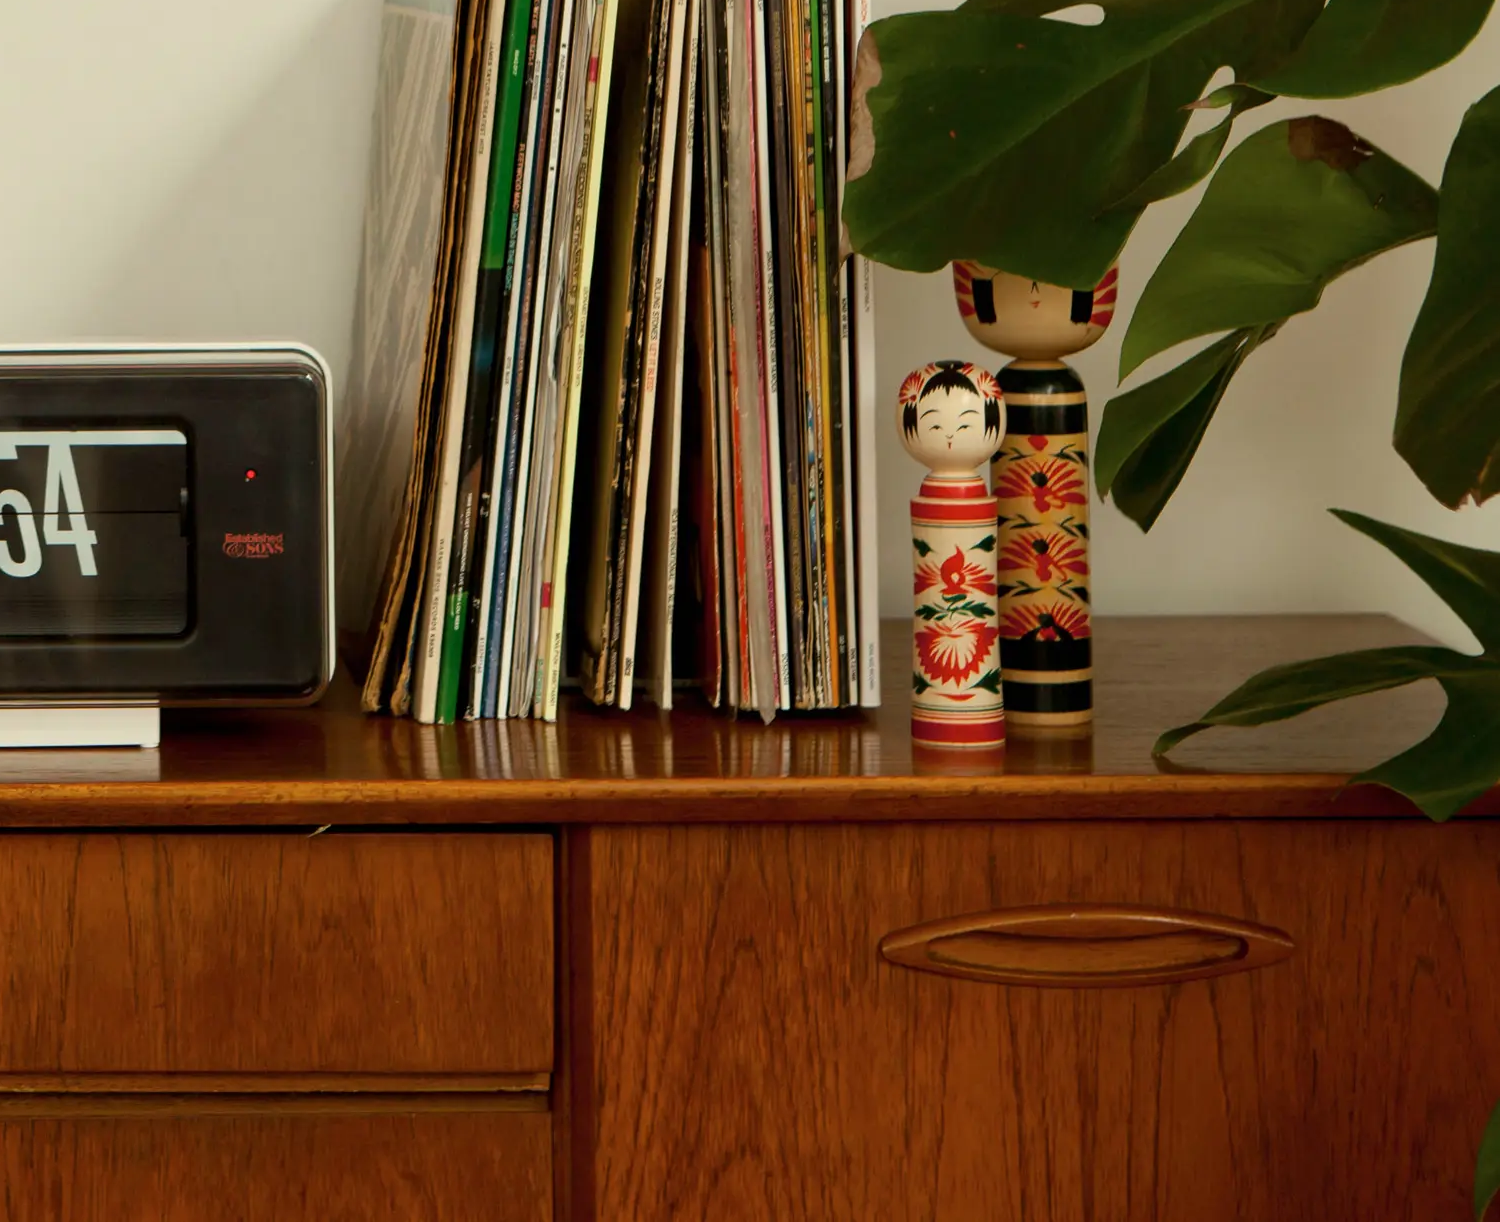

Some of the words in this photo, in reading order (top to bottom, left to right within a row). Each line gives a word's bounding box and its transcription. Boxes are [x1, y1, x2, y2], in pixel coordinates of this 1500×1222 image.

[487, 40, 495, 66] JAMES
[484, 68, 493, 96] TAYLOR
[514, 144, 526, 191] FLEETWOOD
[576, 162, 588, 208] REDDING
[652, 278, 662, 310] ROLLING
[650, 311, 660, 340] STONES
[648, 342, 658, 356] LET
[646, 368, 656, 392] BLEED
[464, 508, 472, 528] VELVET
[224, 532, 284, 543] Established
[246, 542, 284, 554] SONS
[436, 538, 445, 571] WARNER
[430, 597, 440, 632] RECORDS
